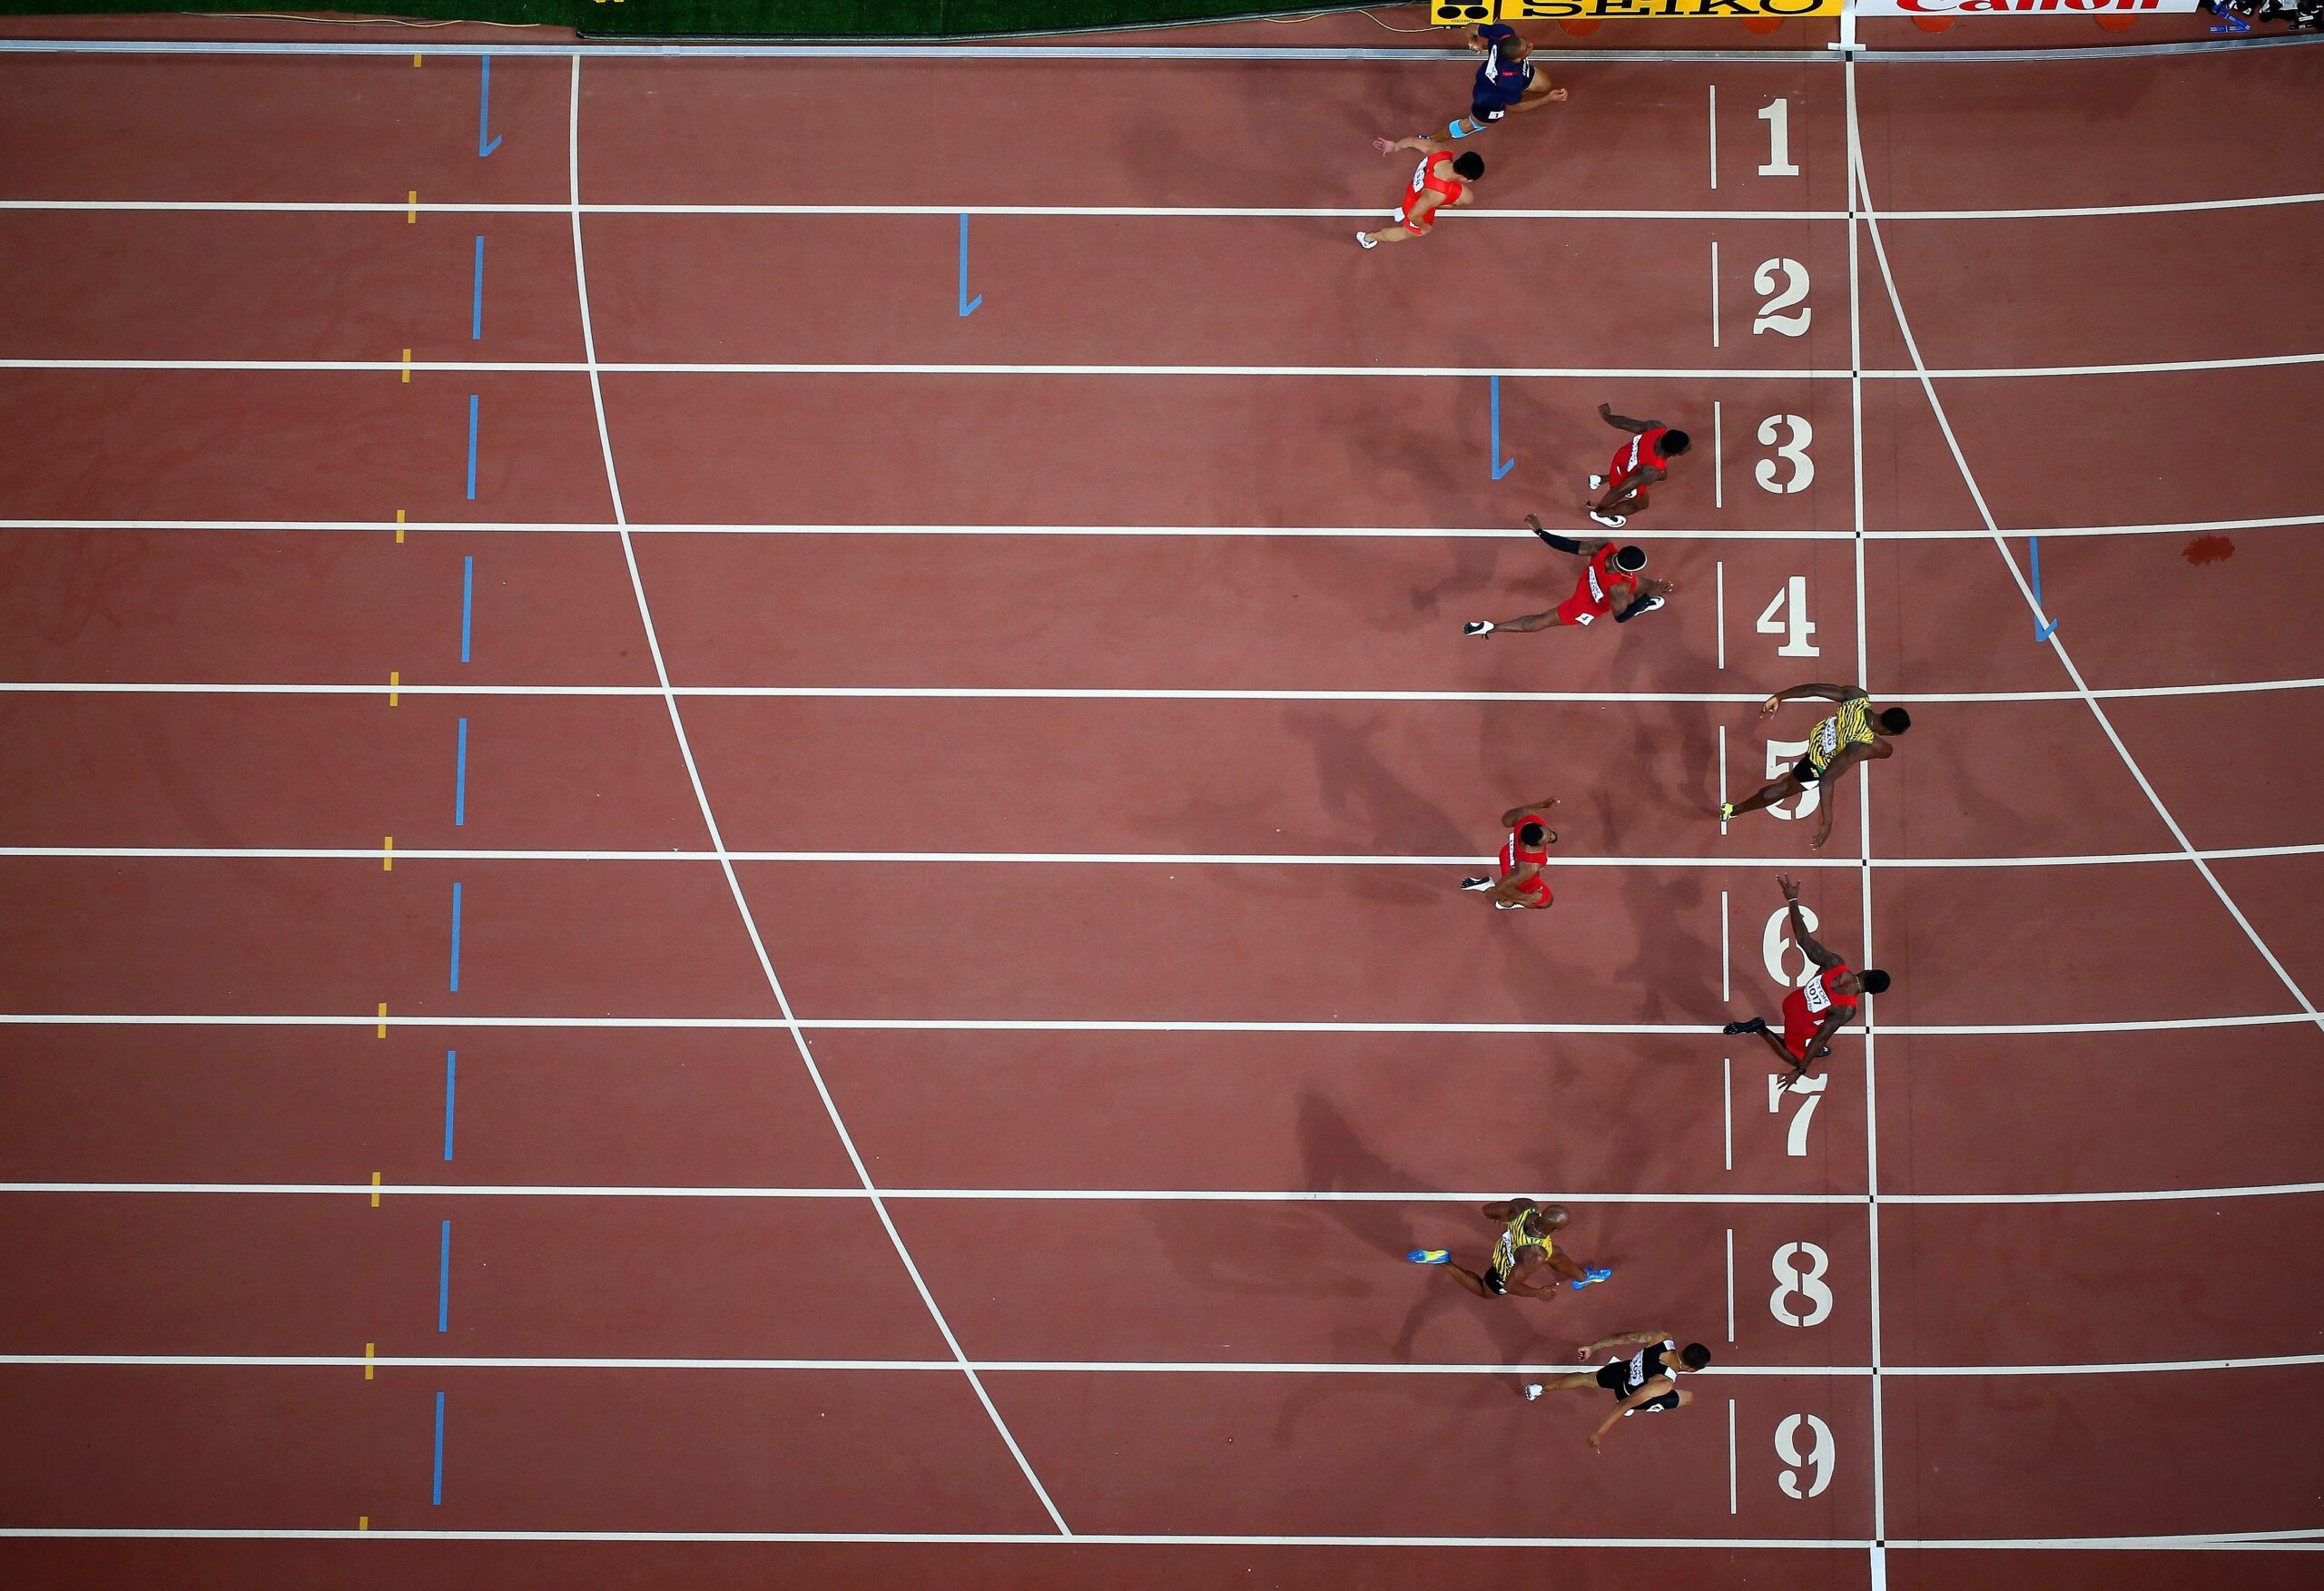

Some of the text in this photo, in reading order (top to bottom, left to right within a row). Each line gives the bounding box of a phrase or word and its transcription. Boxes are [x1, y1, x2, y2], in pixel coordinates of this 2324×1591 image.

[1758, 99, 1798, 176] 1
[1754, 258, 1811, 336] 2
[1757, 415, 1814, 493] 3
[1756, 576, 1819, 656] 4
[1764, 740, 1821, 820] 5
[1763, 905, 1820, 987] 6
[1808, 982, 1822, 1005] 1017
[1768, 1073, 1828, 1156] 7
[1770, 1242, 1832, 1326] 8
[1775, 1414, 1835, 1498] 9
